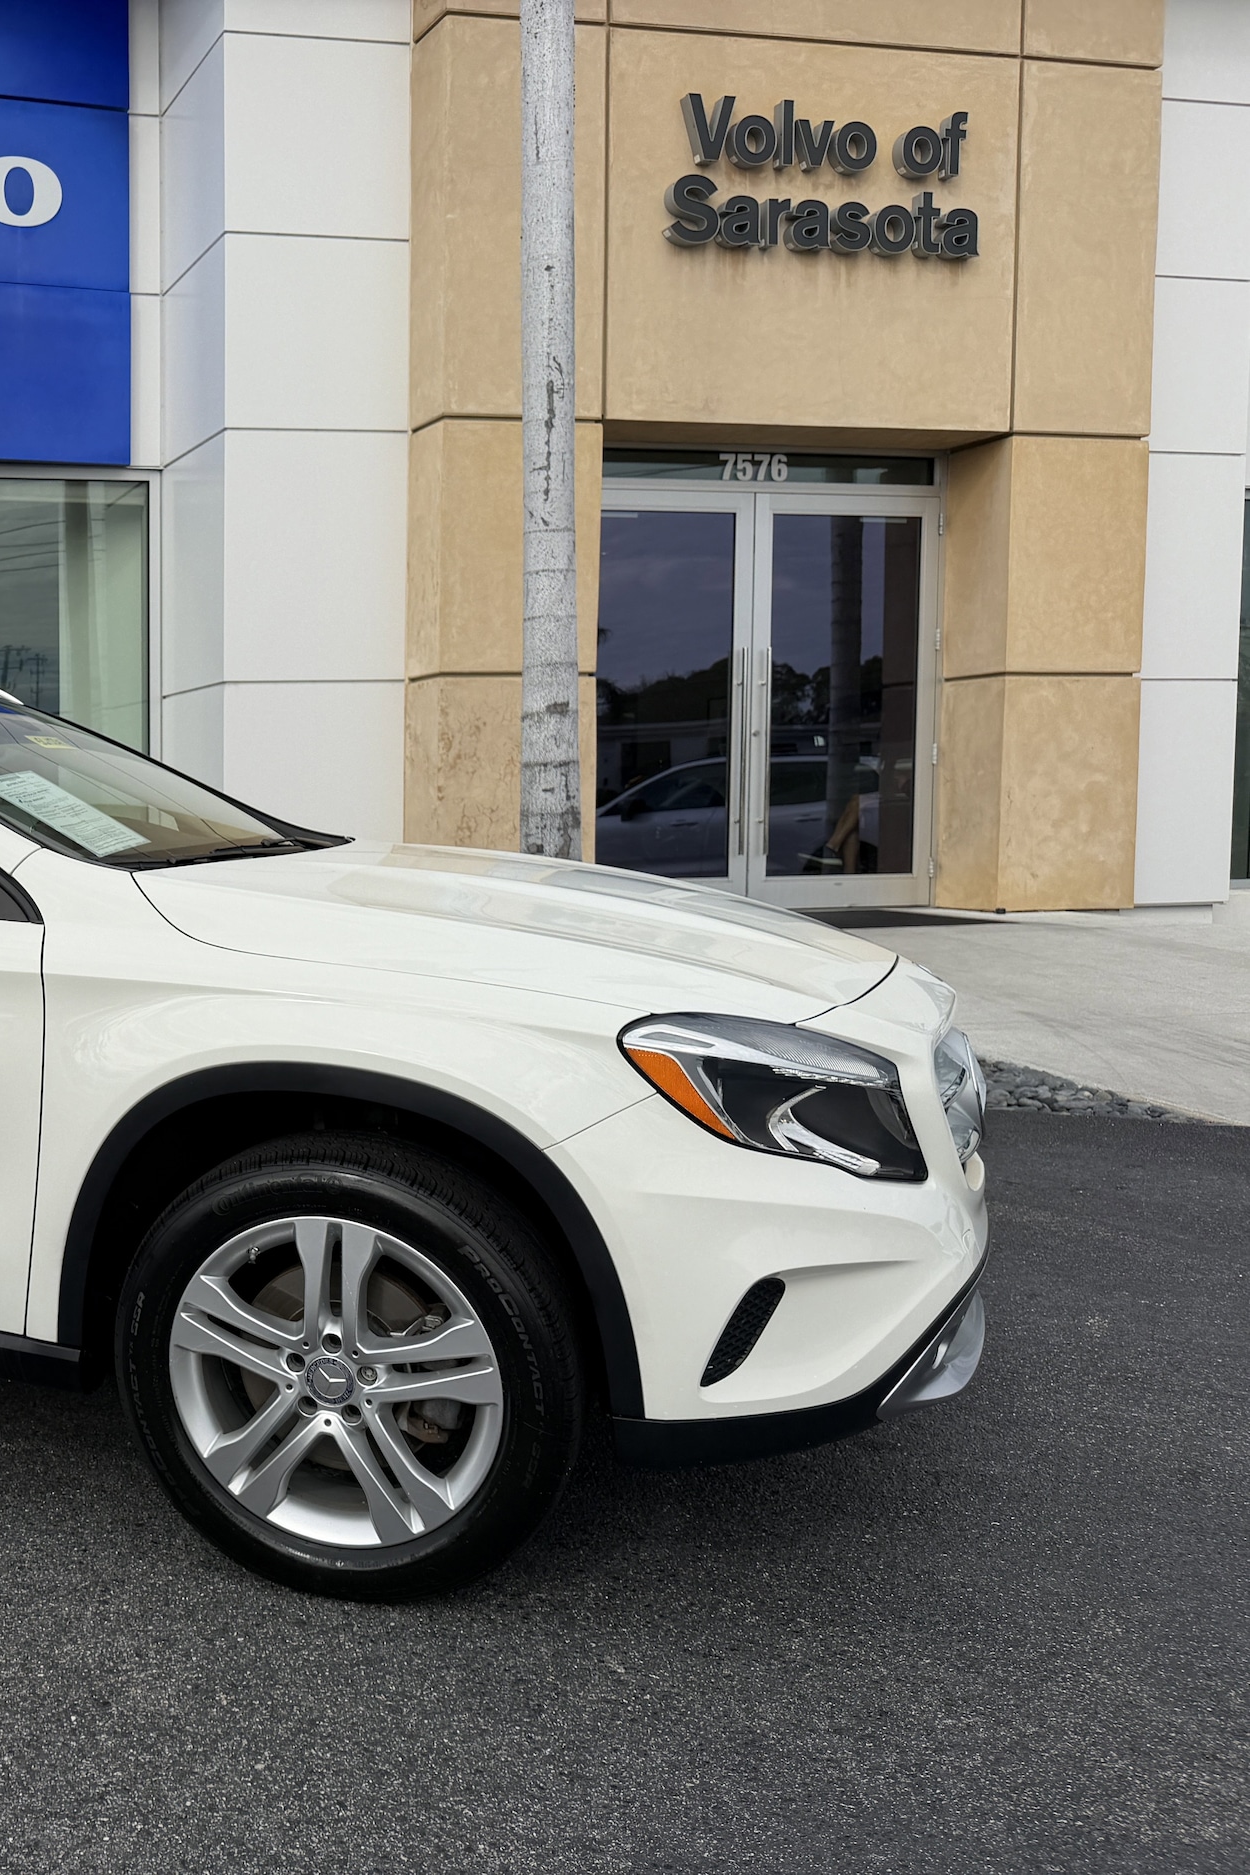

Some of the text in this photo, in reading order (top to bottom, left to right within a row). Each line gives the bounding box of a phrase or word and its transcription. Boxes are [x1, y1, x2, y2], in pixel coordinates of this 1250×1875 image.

[680, 93, 969, 181] Volvo of
[662, 174, 980, 260] Sarasota
[719, 453, 788, 483] 7576
